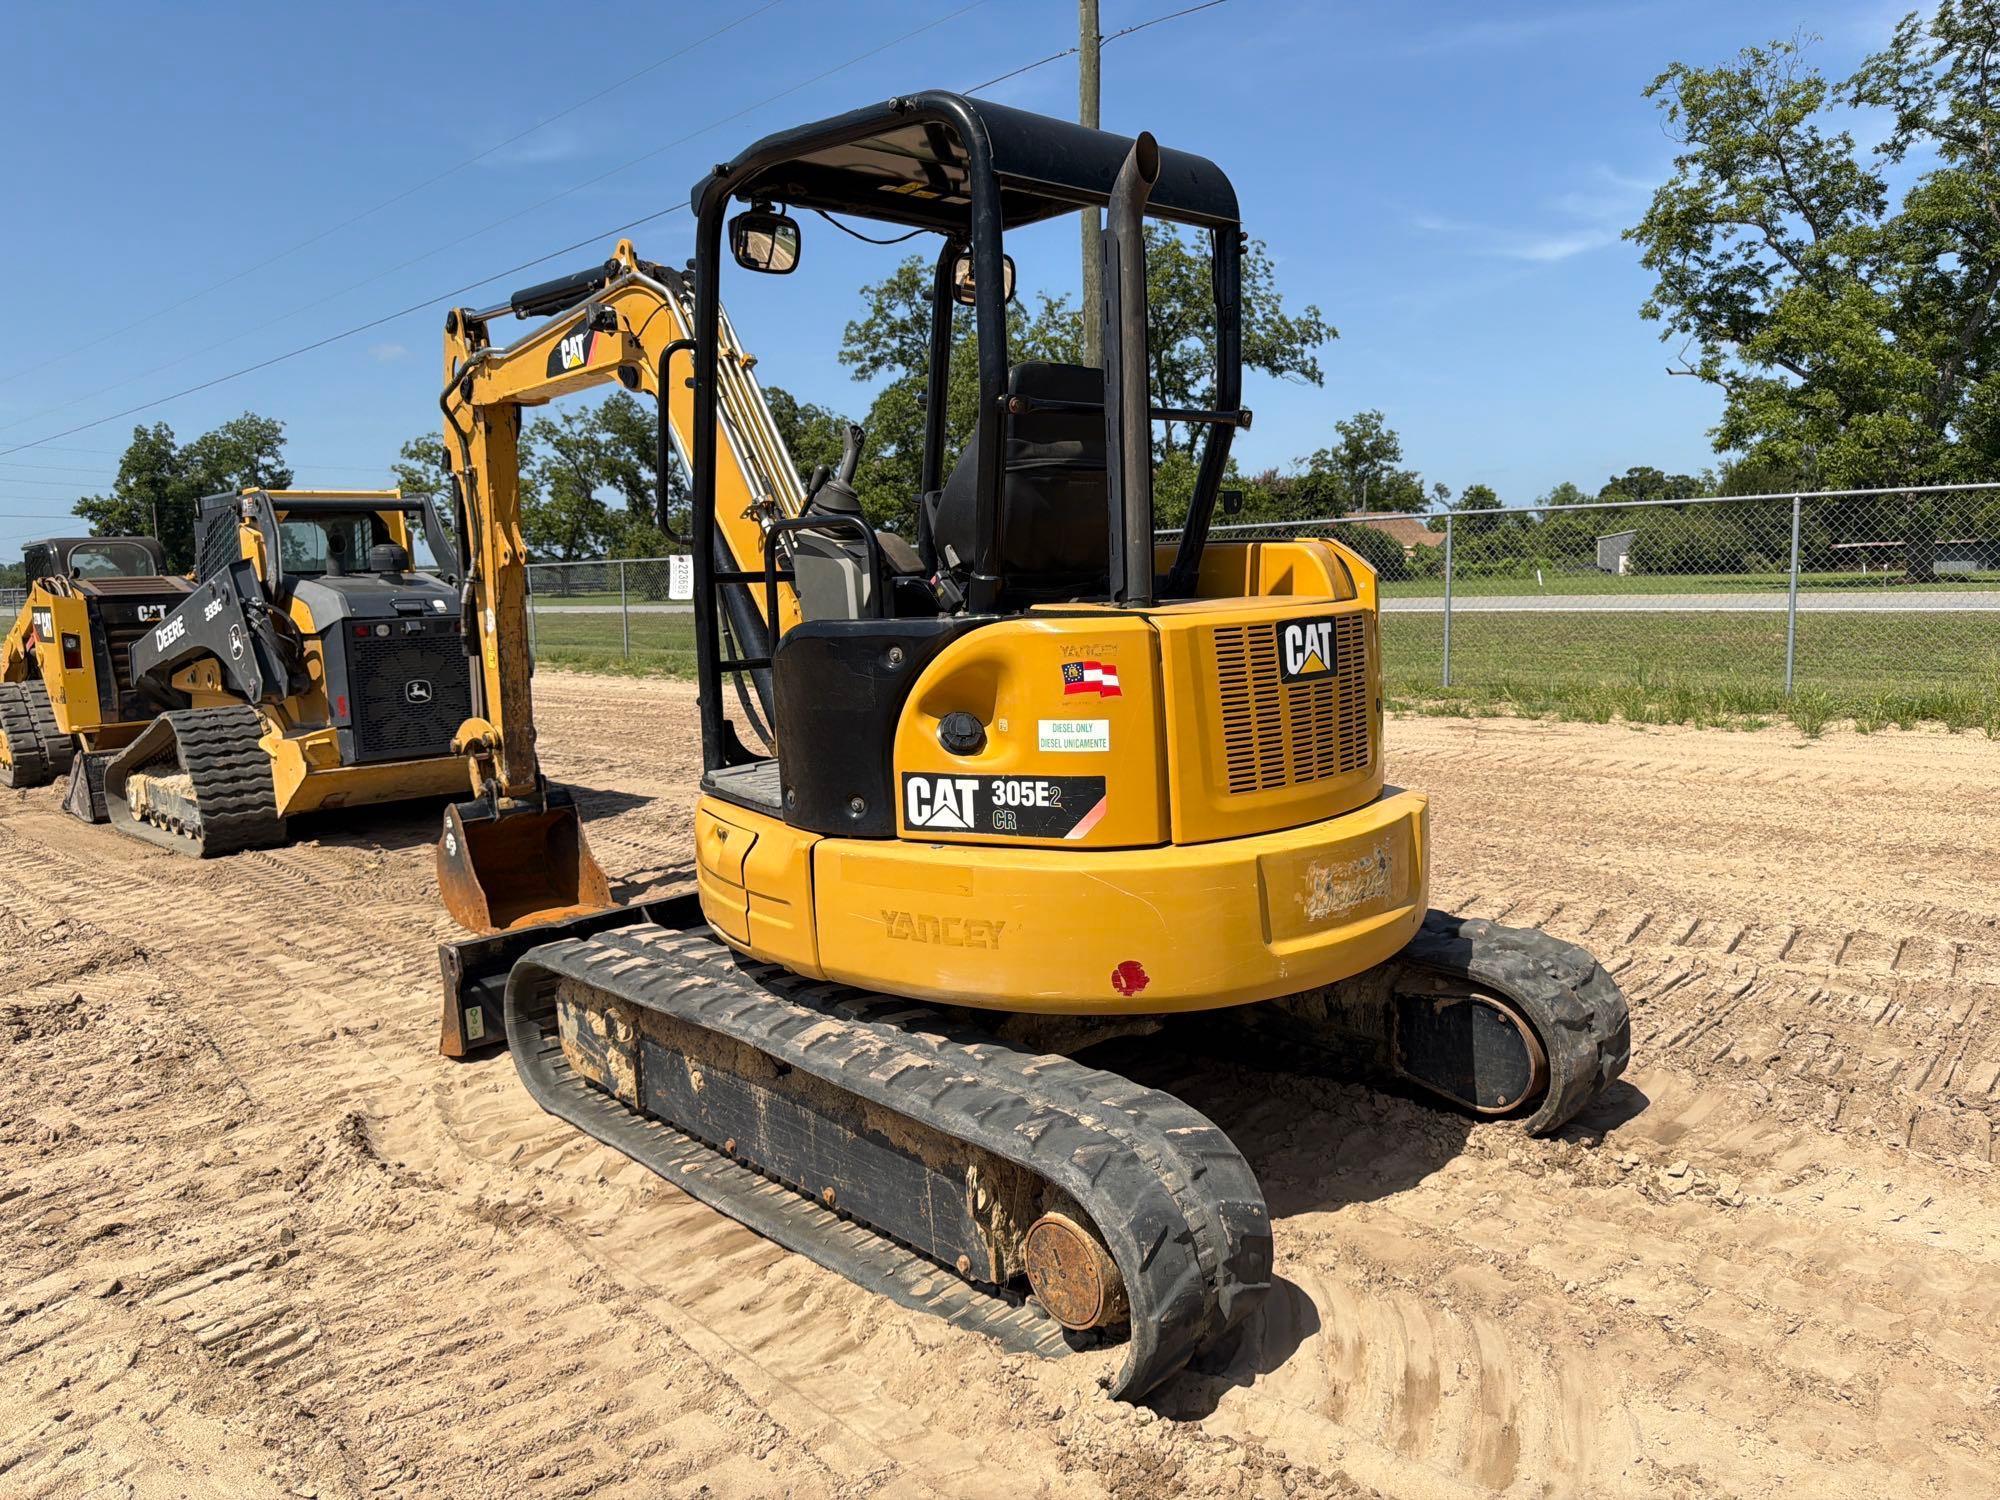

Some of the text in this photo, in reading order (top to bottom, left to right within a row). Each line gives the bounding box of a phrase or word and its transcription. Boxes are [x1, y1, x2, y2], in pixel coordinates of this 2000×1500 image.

[561, 333, 585, 369] CAT
[138, 604, 167, 622] CAT
[204, 598, 223, 622] 333G
[41, 611, 53, 637] CAT
[155, 614, 185, 653] DEERE
[1285, 622, 1332, 675] CAT
[1052, 722, 1093, 733] DIESEL ONLY
[1040, 738, 1107, 749] DIESEL UNICAMENTE
[906, 777, 980, 828] CAT
[992, 809, 1017, 830] CR
[880, 909, 1006, 950] YANCEY
